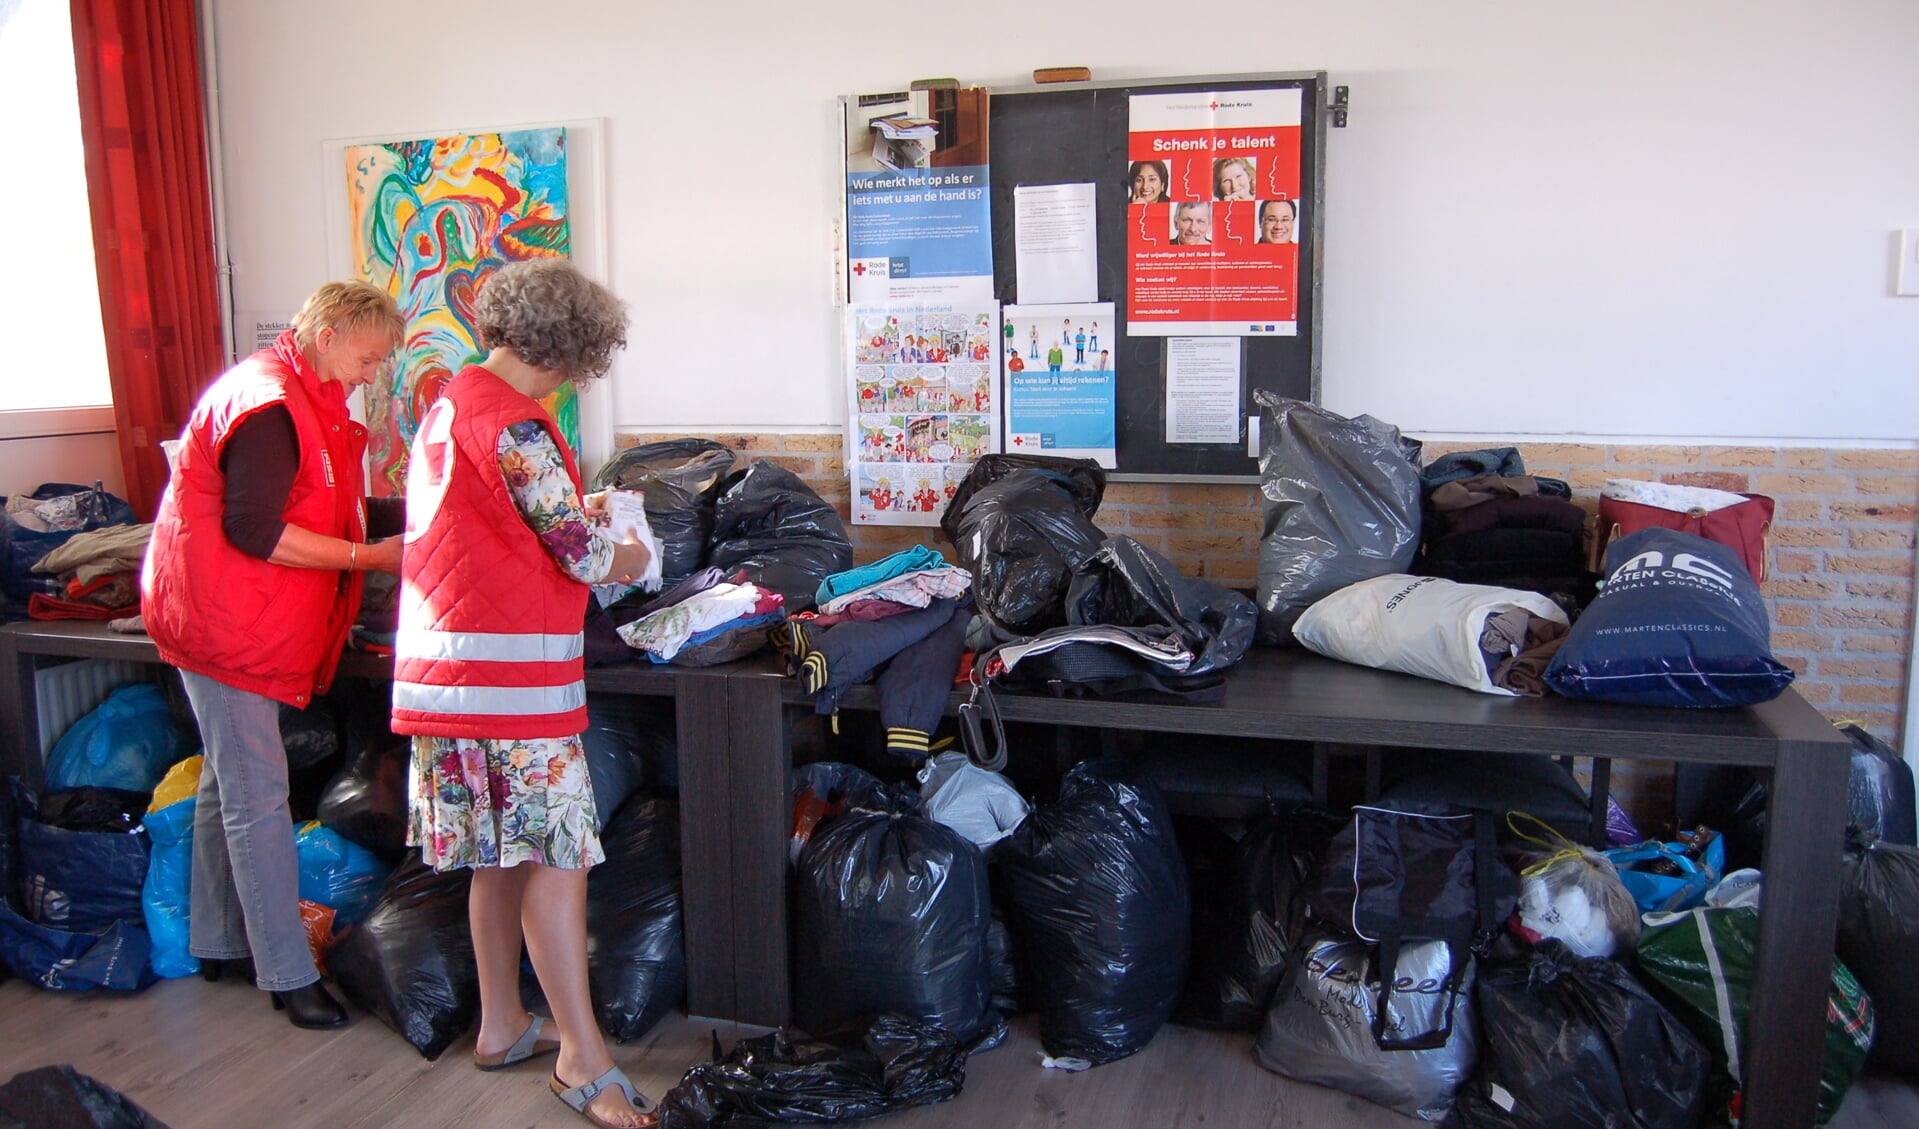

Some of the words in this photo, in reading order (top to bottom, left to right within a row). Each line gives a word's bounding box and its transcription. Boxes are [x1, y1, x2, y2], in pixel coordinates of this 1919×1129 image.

[1152, 137, 1208, 151] Schenk
[1211, 136, 1227, 152] je
[1230, 135, 1276, 149] talent
[853, 179, 873, 189] Wie
[876, 176, 906, 188] merkt
[908, 175, 926, 186] het
[930, 176, 942, 187] op
[944, 173, 960, 184] als
[962, 175, 974, 184] er
[874, 195, 893, 204] met
[895, 195, 901, 203] u
[903, 195, 920, 203] aan
[924, 192, 937, 201] de
[939, 190, 966, 201] hand
[968, 189, 982, 199] is?
[1013, 377, 1024, 386] Op
[1599, 582, 1646, 598] CASUAL
[1595, 623, 1728, 636] WWW.MARTENCLASSICS.NL
